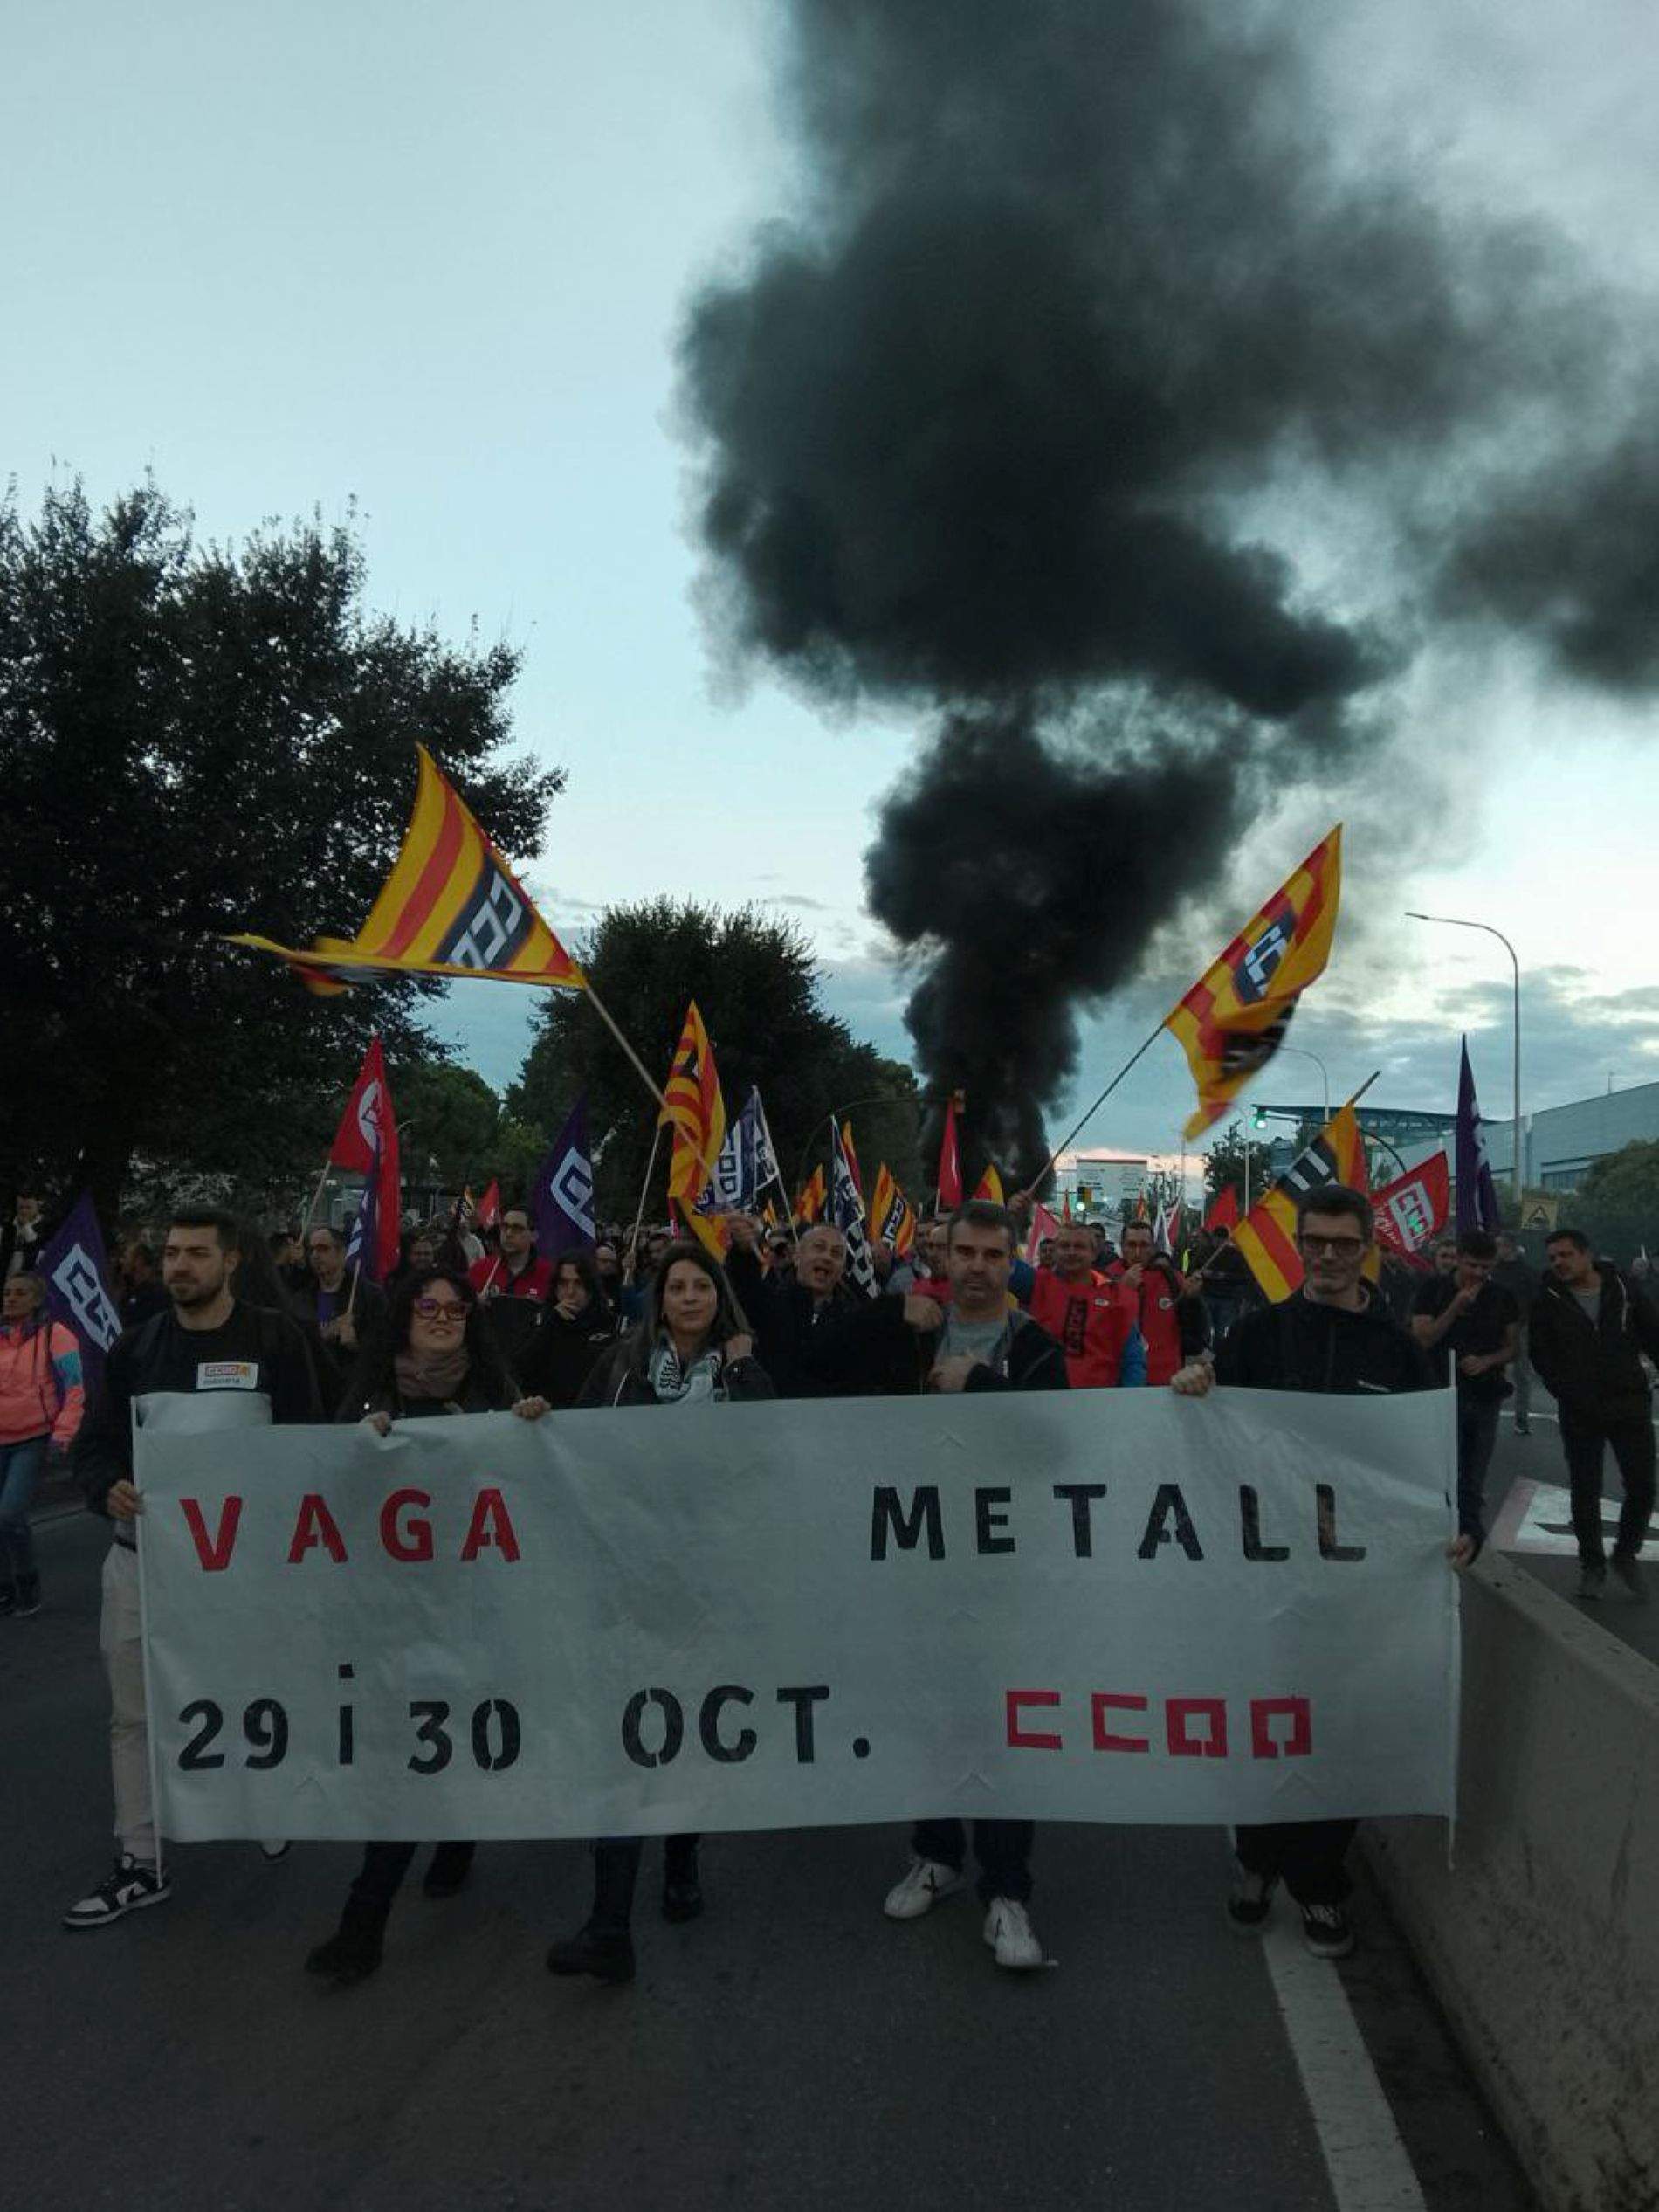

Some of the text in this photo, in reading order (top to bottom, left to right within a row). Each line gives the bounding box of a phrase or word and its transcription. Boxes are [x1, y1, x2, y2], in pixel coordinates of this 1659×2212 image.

[179, 1483, 1367, 1572] VAGA METALL
[177, 1663, 1313, 1776] 29 i 30 OCT. CCOO
